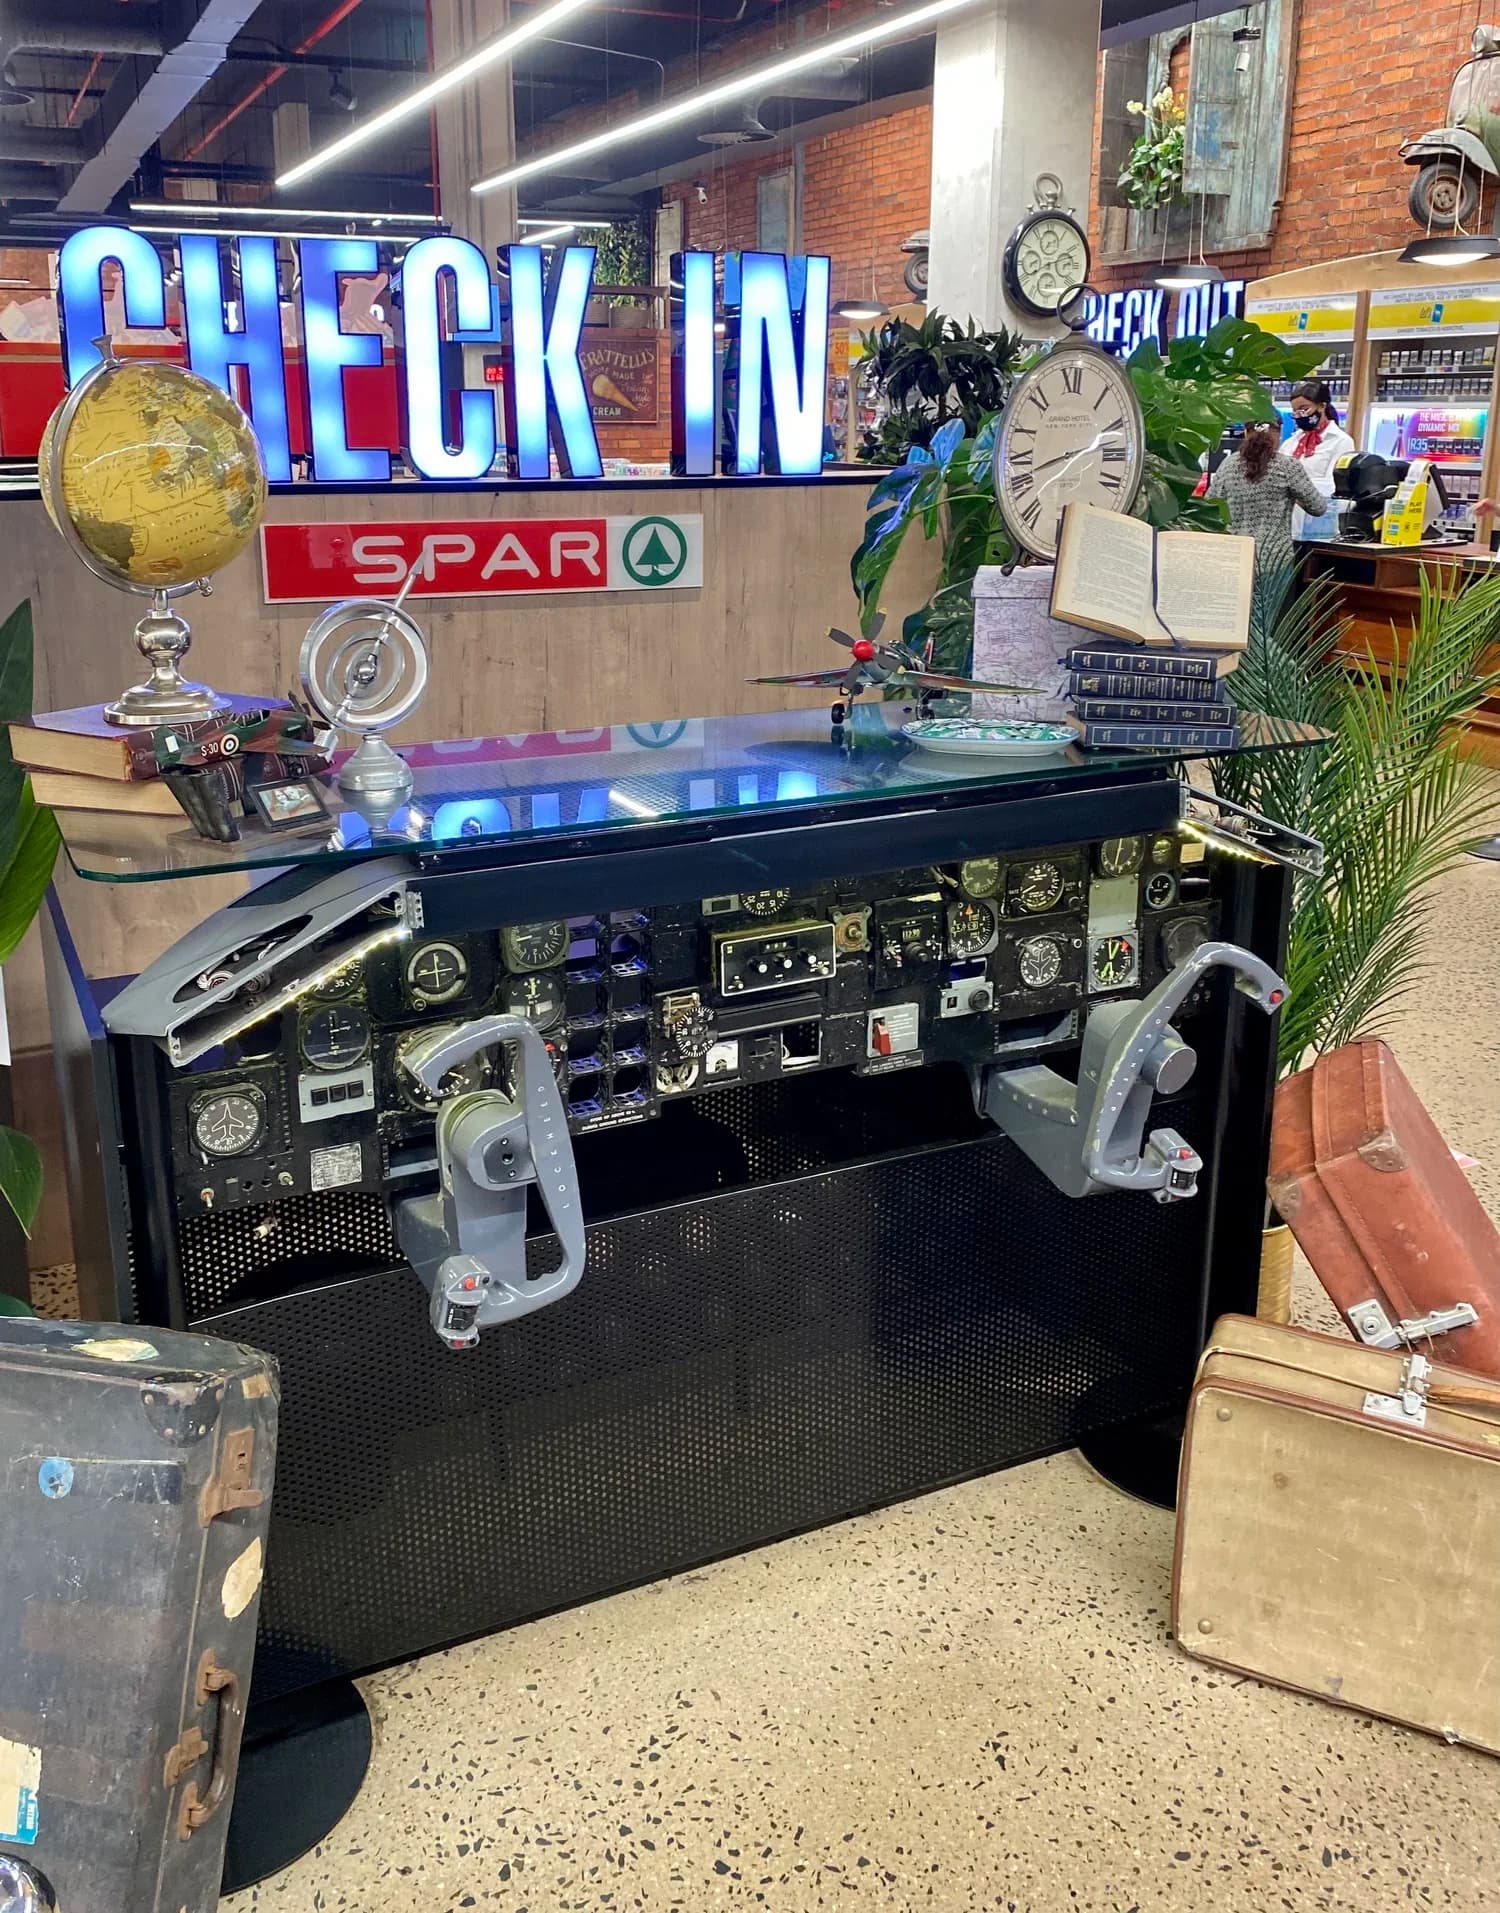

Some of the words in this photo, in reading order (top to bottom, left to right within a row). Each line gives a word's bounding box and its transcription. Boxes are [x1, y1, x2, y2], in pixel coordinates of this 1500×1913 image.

[60, 225, 605, 479] CHECK
[684, 249, 831, 475] IN
[613, 370, 635, 380] MADE
[592, 406, 621, 416] CREAM
[1409, 438, 1428, 451] R35
[352, 530, 601, 584] SPAR
[200, 742, 219, 757] S-30
